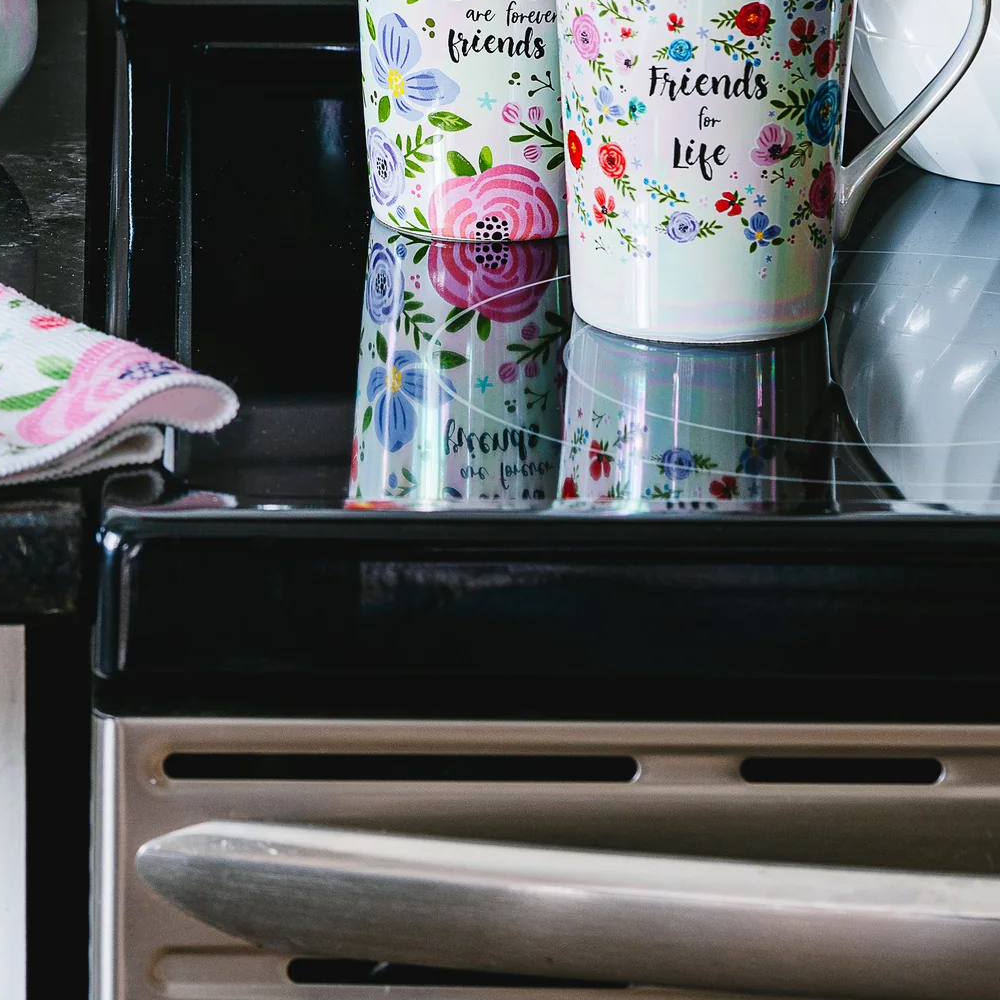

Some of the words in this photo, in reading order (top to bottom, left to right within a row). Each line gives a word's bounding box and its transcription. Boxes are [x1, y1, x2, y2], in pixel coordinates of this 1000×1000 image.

[466, 10, 495, 21] are
[448, 27, 546, 63] friends
[649, 60, 769, 101] Friends
[699, 106, 721, 130] for
[673, 138, 728, 181] Life
